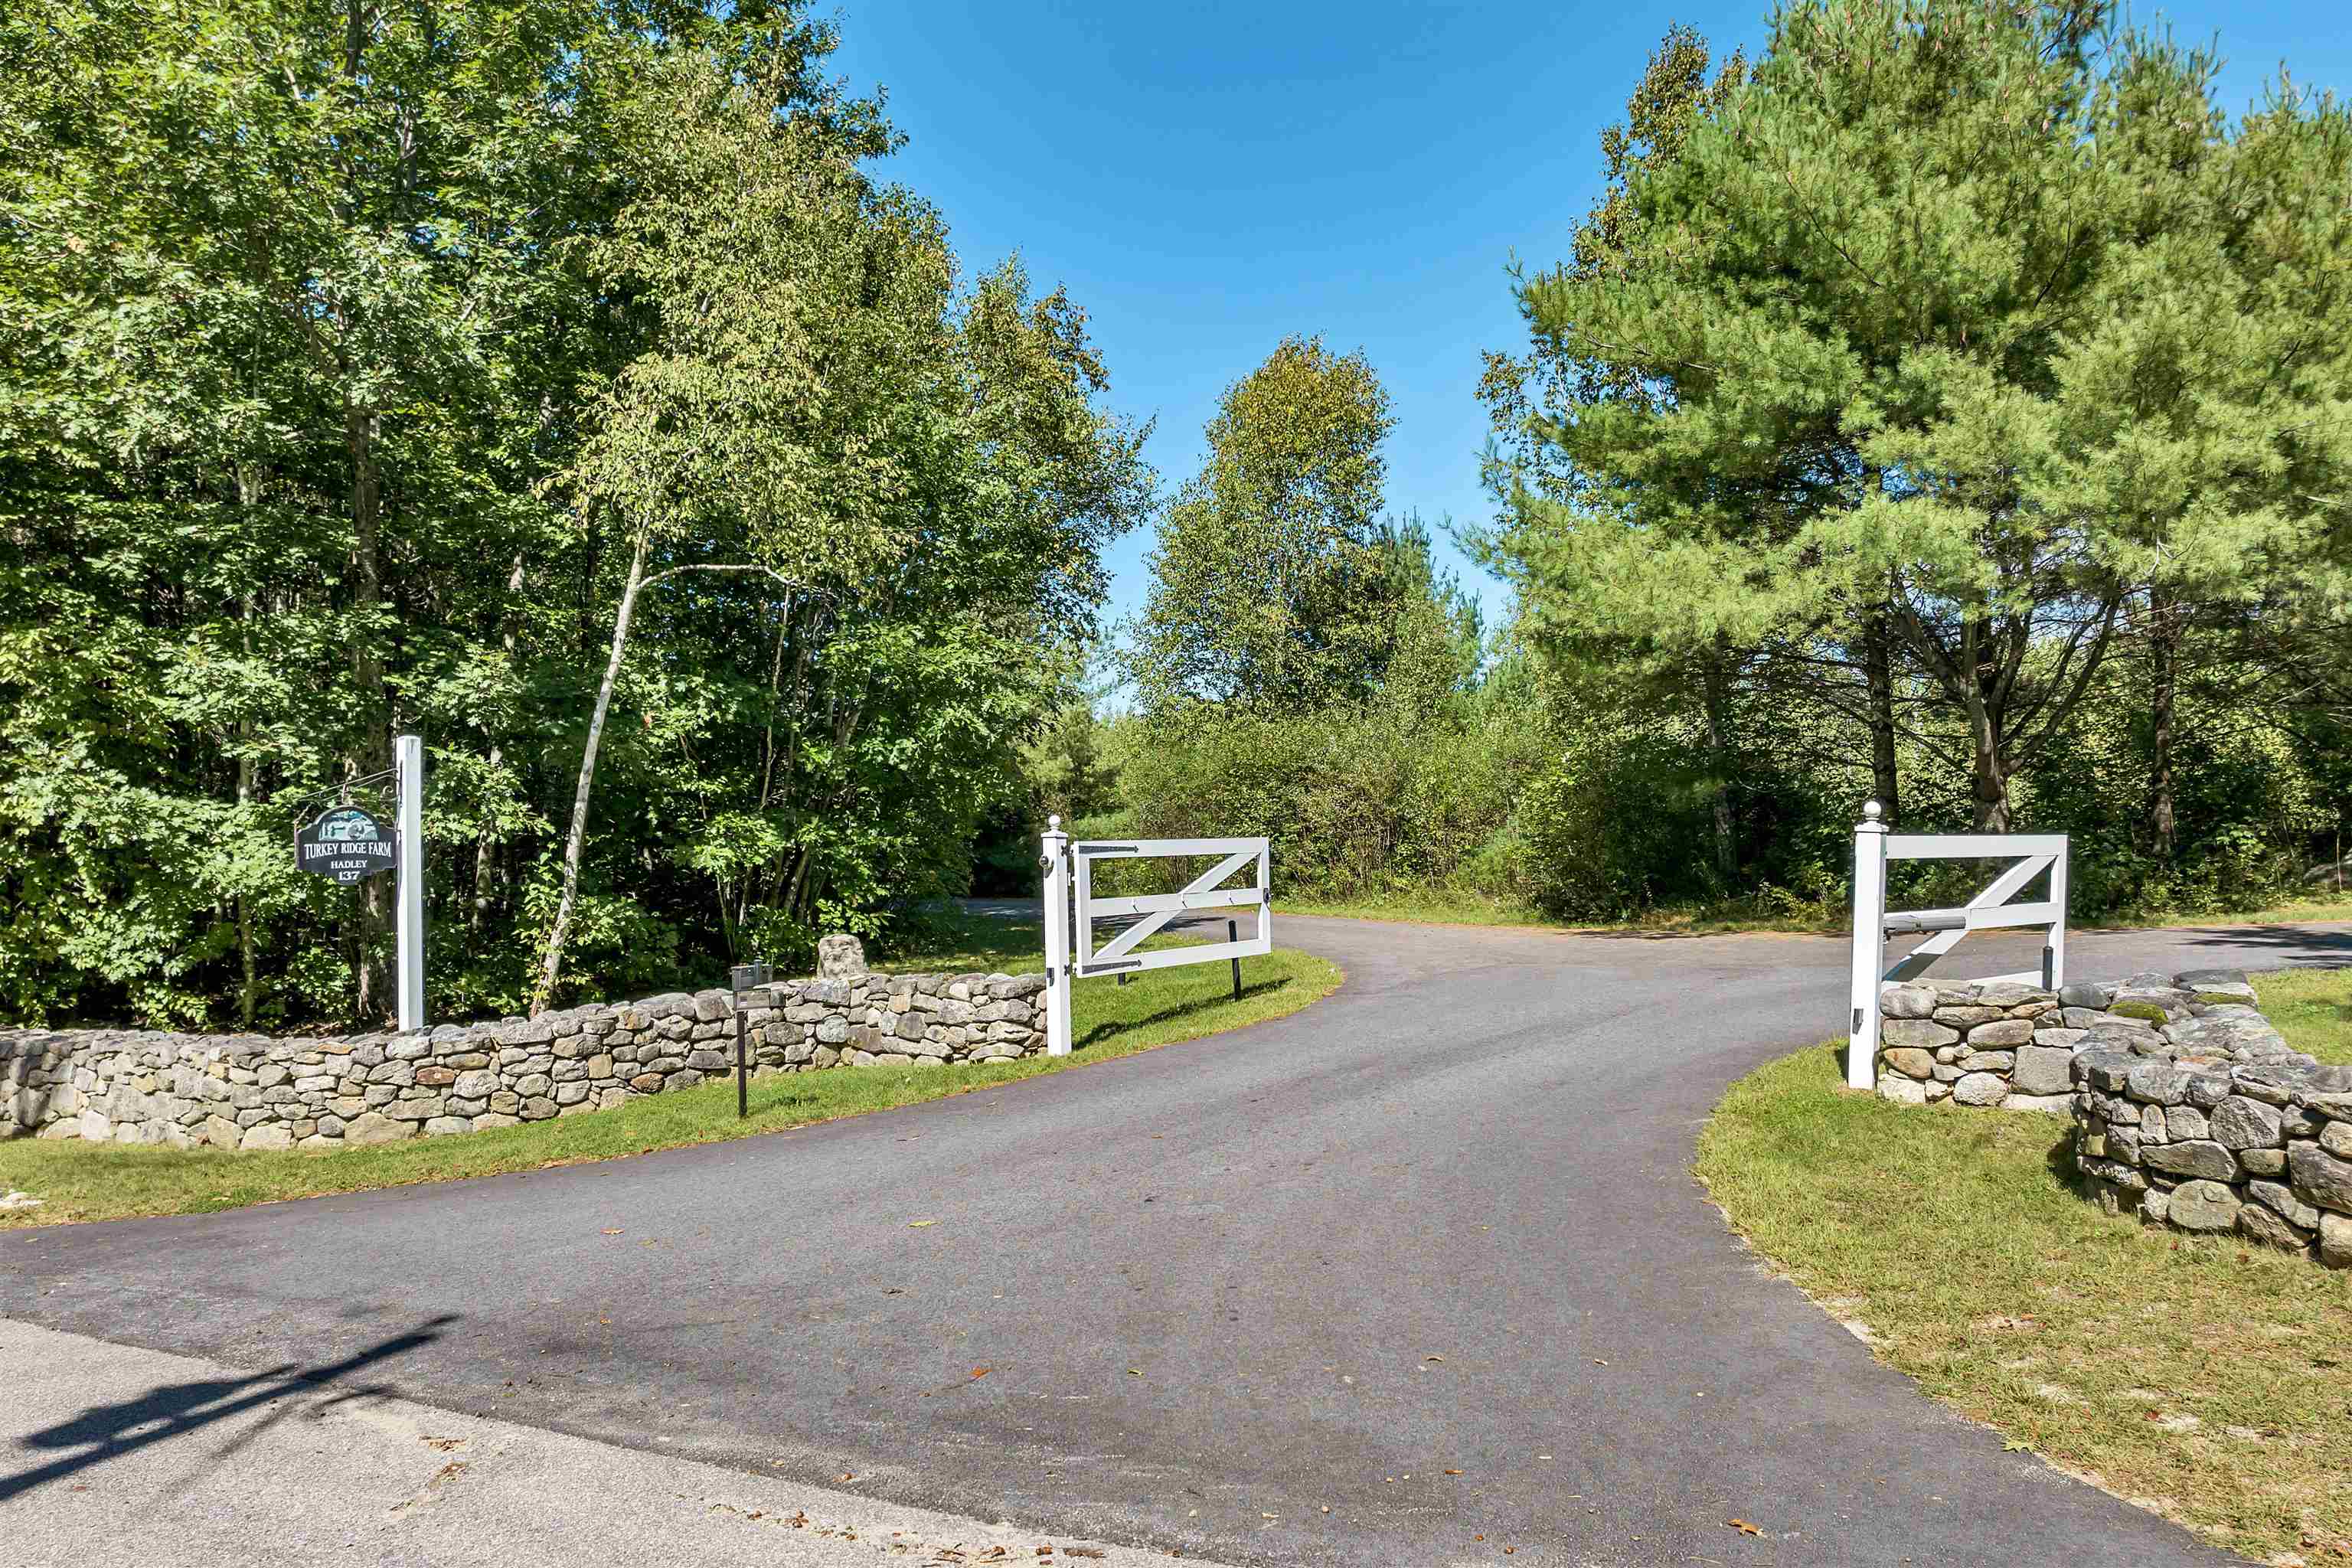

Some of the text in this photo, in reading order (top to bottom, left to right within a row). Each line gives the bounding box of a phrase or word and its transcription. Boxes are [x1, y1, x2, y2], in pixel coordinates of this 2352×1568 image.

[304, 841, 392, 860] TURKEY RIDGE FARM
[331, 860, 368, 869] HADLEY
[338, 871, 360, 880] 137
